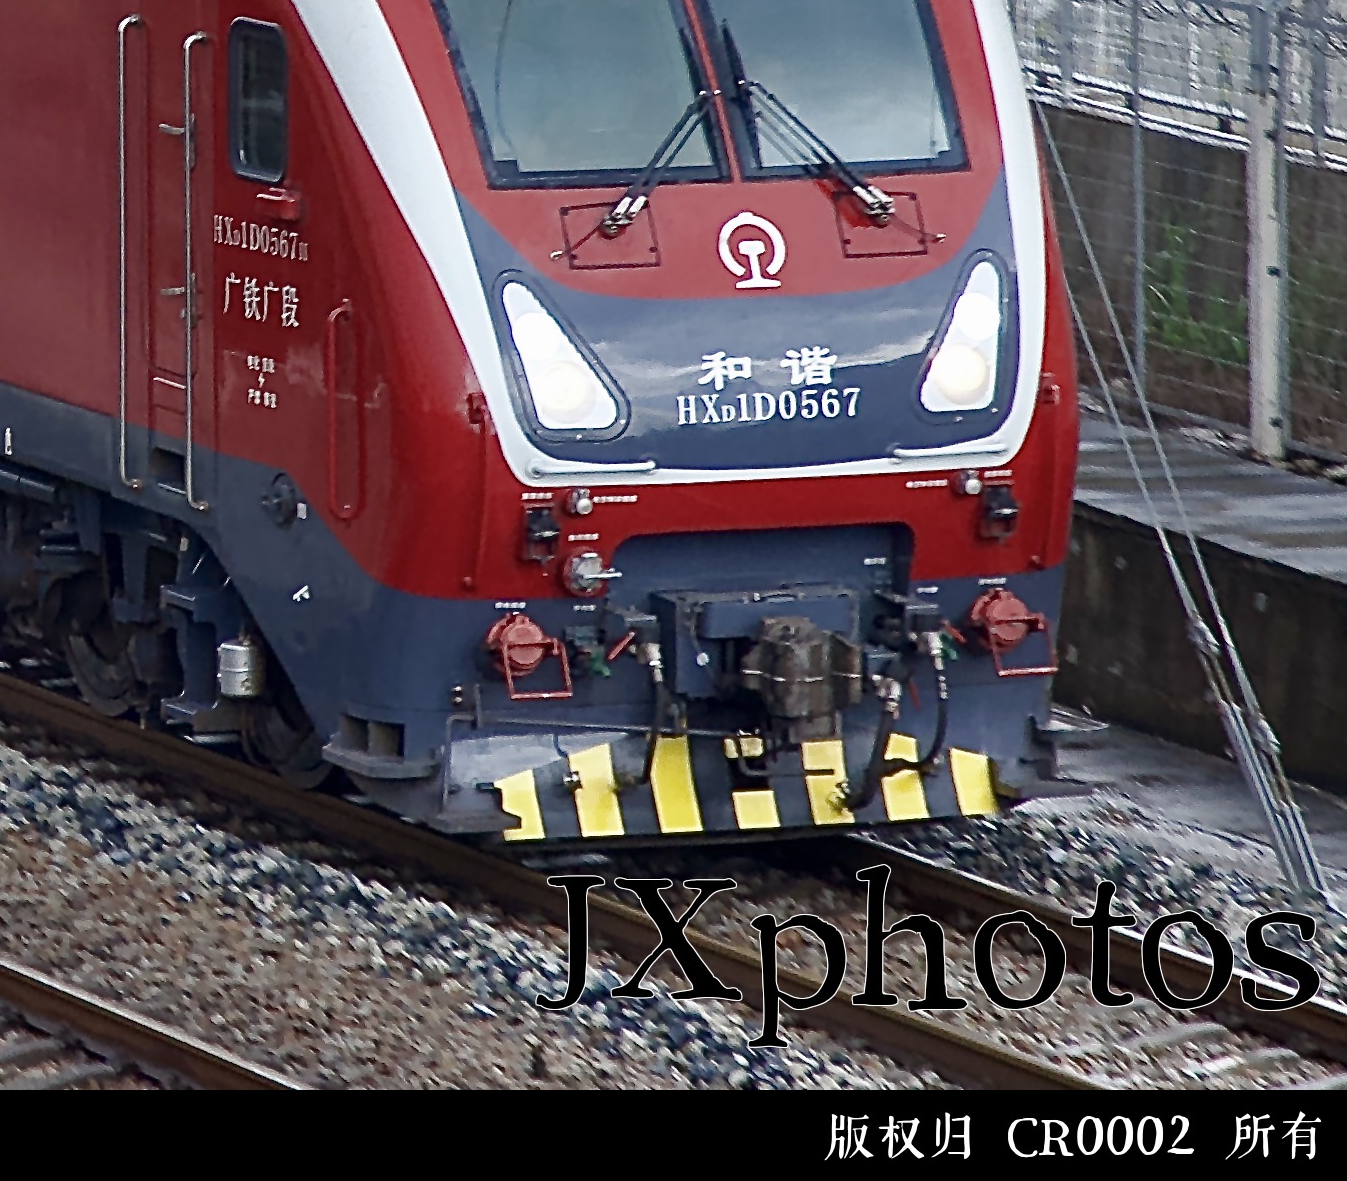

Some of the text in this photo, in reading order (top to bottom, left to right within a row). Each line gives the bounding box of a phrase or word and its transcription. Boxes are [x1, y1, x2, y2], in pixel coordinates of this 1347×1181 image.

[223, 271, 300, 328] 广铁广段
[697, 345, 838, 392] 和谐
